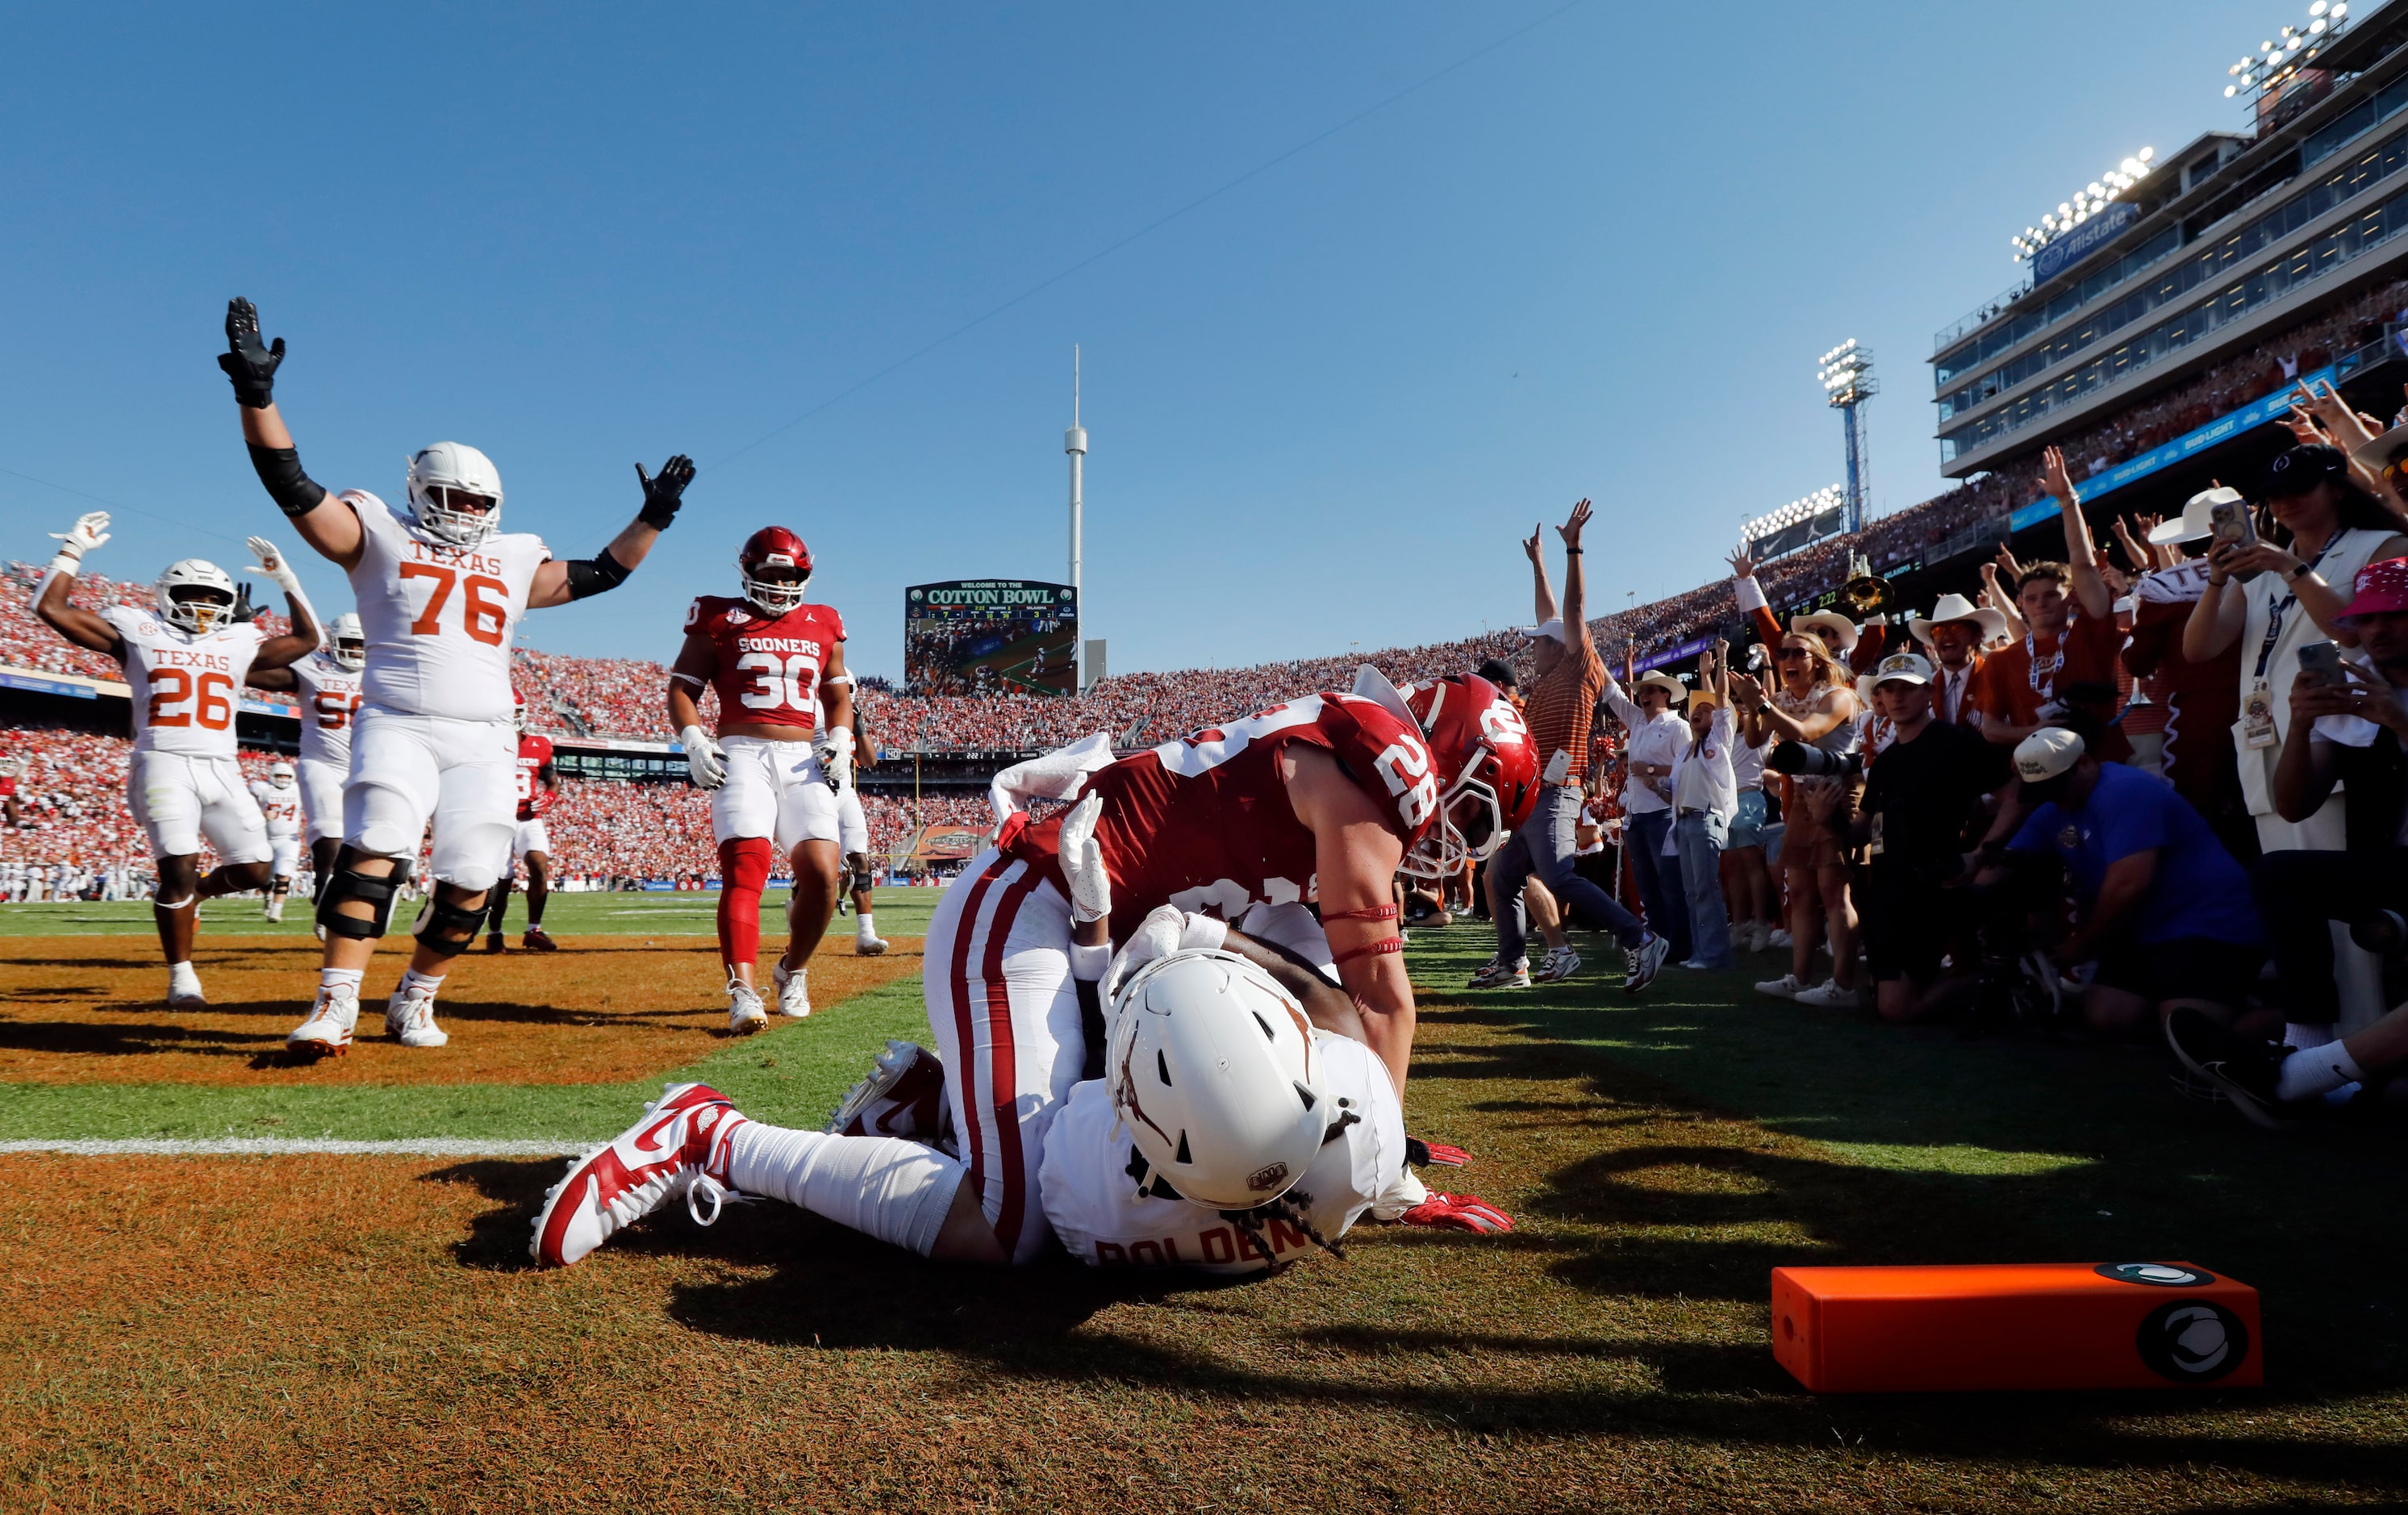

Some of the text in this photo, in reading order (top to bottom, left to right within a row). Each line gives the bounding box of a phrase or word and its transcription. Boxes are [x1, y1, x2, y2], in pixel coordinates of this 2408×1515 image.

[2065, 211, 2126, 259] Allstate
[2185, 420, 2234, 450] BUD LIGHT
[2114, 457, 2156, 482] BUD LIGHT
[409, 540, 501, 576] TEXAS
[1884, 564, 1911, 579] OKLAHOMA
[399, 561, 509, 647] 76
[928, 590, 1054, 604] COTTON BOWL
[1819, 591, 1836, 607] 2:22
[152, 649, 230, 671] TEXAS
[738, 637, 820, 657] SOONERS
[737, 653, 821, 714] 30
[148, 668, 234, 731] 26
[1373, 733, 1437, 830] 28
